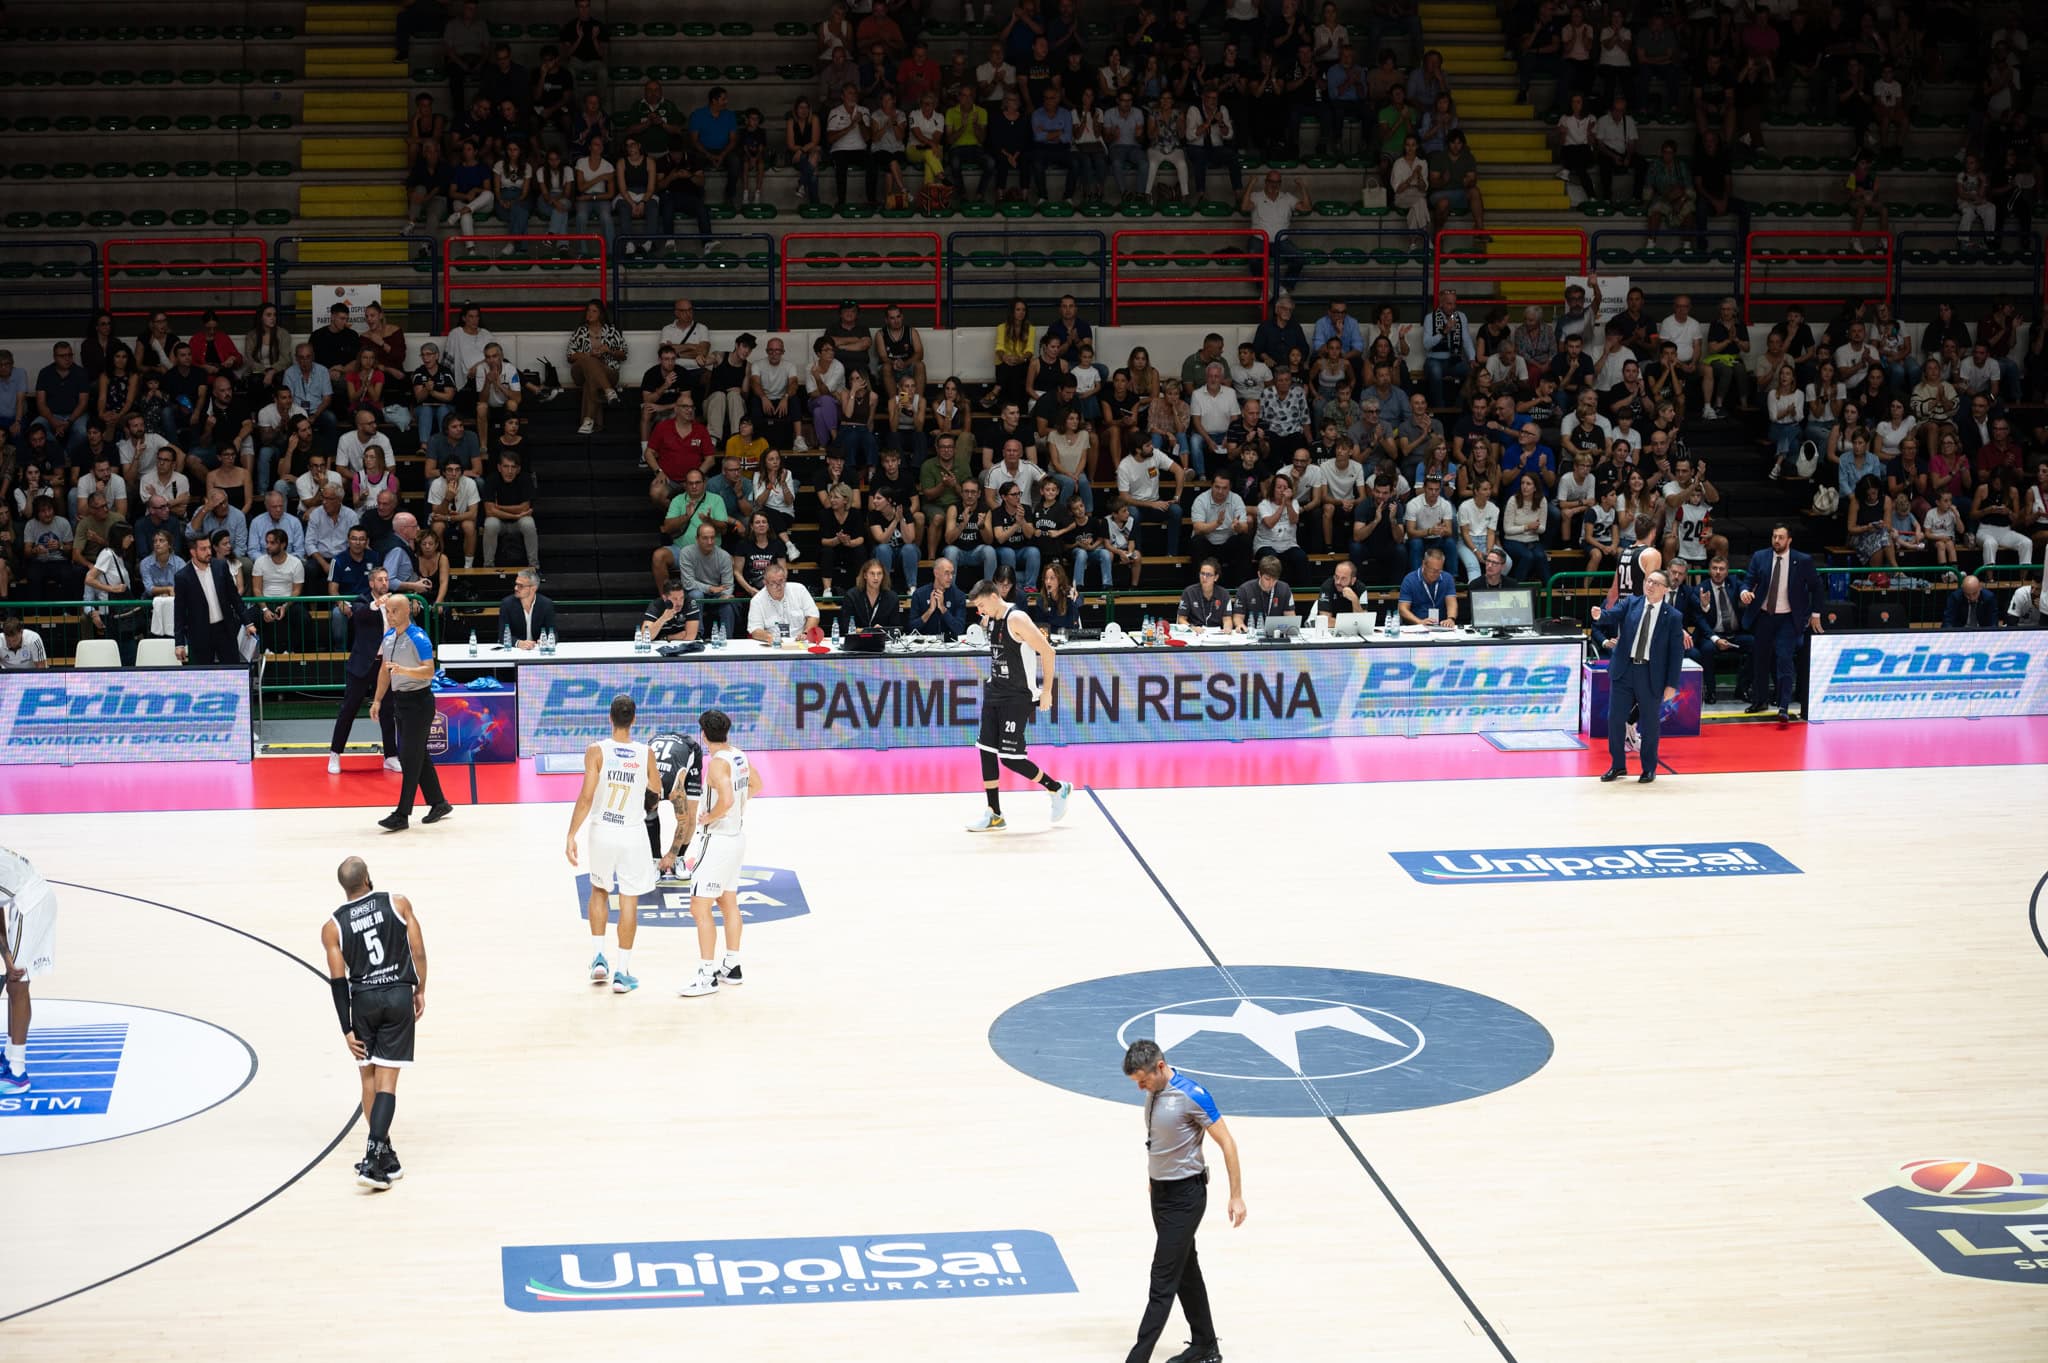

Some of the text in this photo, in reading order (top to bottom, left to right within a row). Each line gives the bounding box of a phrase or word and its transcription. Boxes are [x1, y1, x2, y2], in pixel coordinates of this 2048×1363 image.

[1619, 565, 1634, 590] 24
[1363, 659, 1571, 690] Prima
[1832, 646, 2030, 676] Prima
[17, 686, 238, 716] Prima
[545, 676, 768, 709] Prima
[1076, 675, 1120, 724] IN
[1138, 671, 1322, 722] RESINA
[1821, 689, 2022, 704] PAVIMENTI SPECIALI
[1351, 703, 1562, 720] PAVIMENTI SPECIALI
[7, 732, 232, 748] PAVIMENTI SPECIALI
[1005, 720, 1016, 733] 20
[608, 783, 632, 812] 77
[1433, 847, 1760, 877] UnipolSai
[1585, 865, 1768, 877] ASSICURAZIONI
[363, 928, 385, 966] 5
[560, 1242, 1022, 1296] UnipolSai
[758, 1276, 1028, 1296] ASSICURAZIONI
